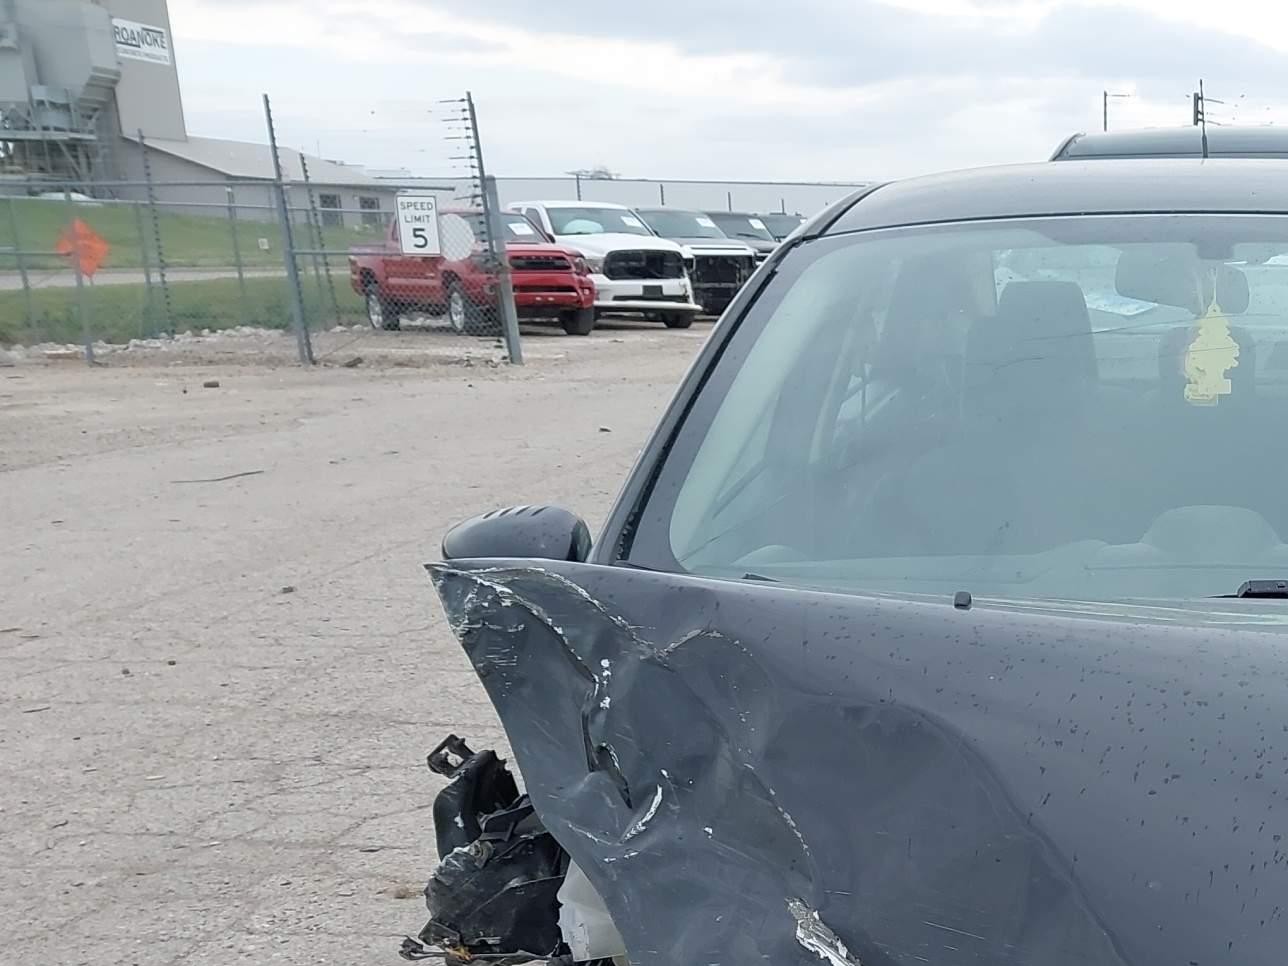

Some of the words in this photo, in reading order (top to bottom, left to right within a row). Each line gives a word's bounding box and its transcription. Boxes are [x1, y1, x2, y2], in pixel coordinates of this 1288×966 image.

[112, 25, 167, 49] ROANOKE
[400, 201, 434, 211] SPEED
[404, 214, 430, 224] LIMIT
[412, 227, 428, 249] 5
